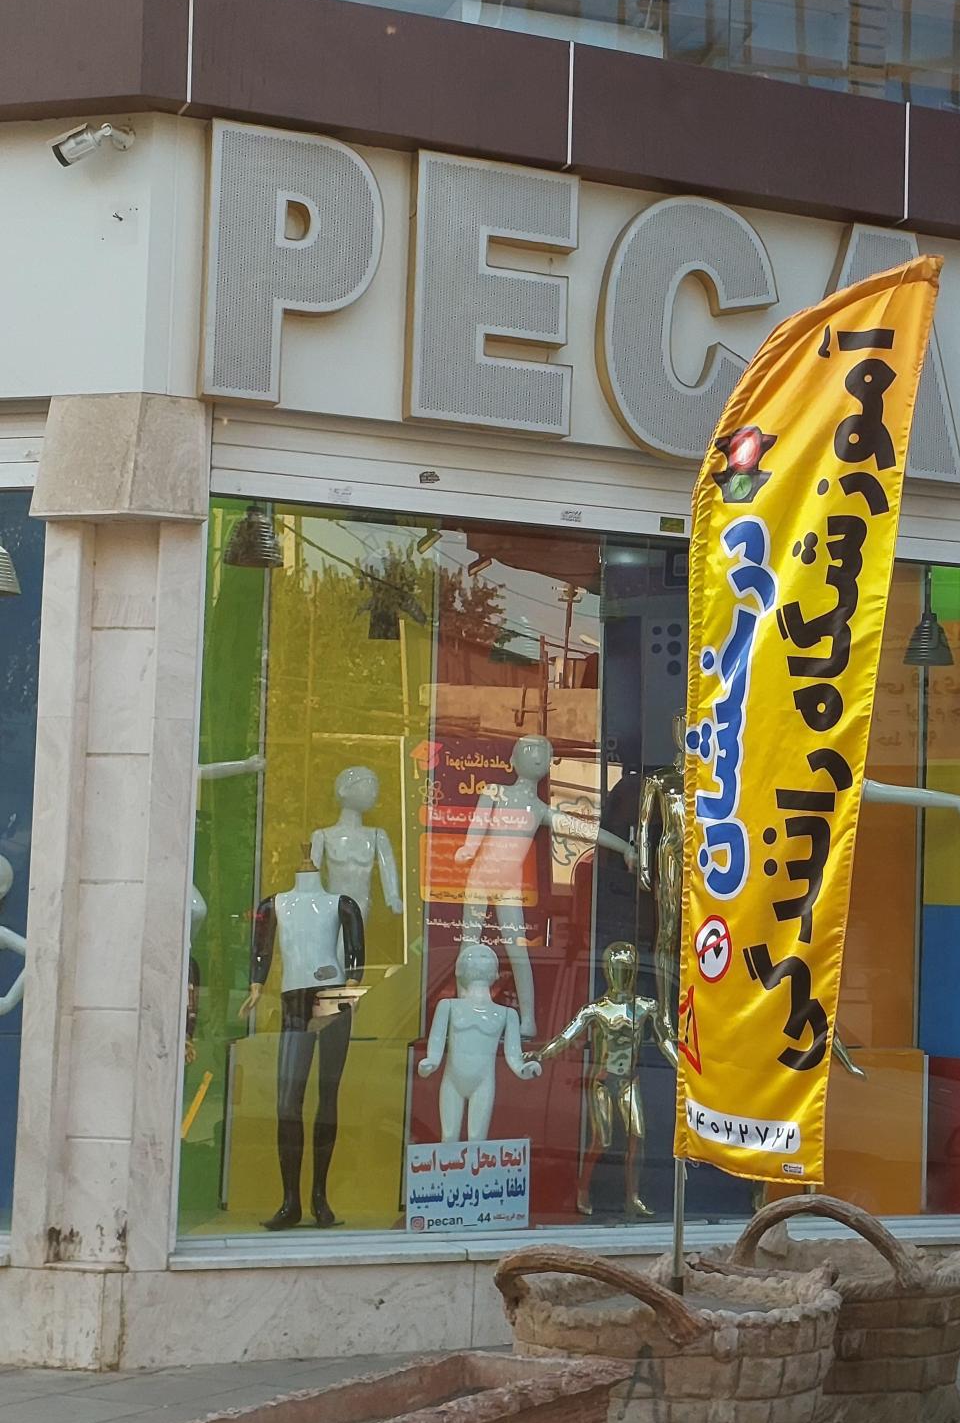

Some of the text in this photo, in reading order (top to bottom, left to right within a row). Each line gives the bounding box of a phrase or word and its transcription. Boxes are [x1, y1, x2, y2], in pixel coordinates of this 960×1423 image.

[686, 516, 779, 900] درخشان
[743, 325, 897, 1071] آموزشگاه رانندگی
[410, 1145, 527, 1177] اینجا محل کسب است
[447, 1182, 480, 1209] ویترین
[482, 1178, 504, 1205] پشت
[506, 1176, 527, 1197] لطفا
